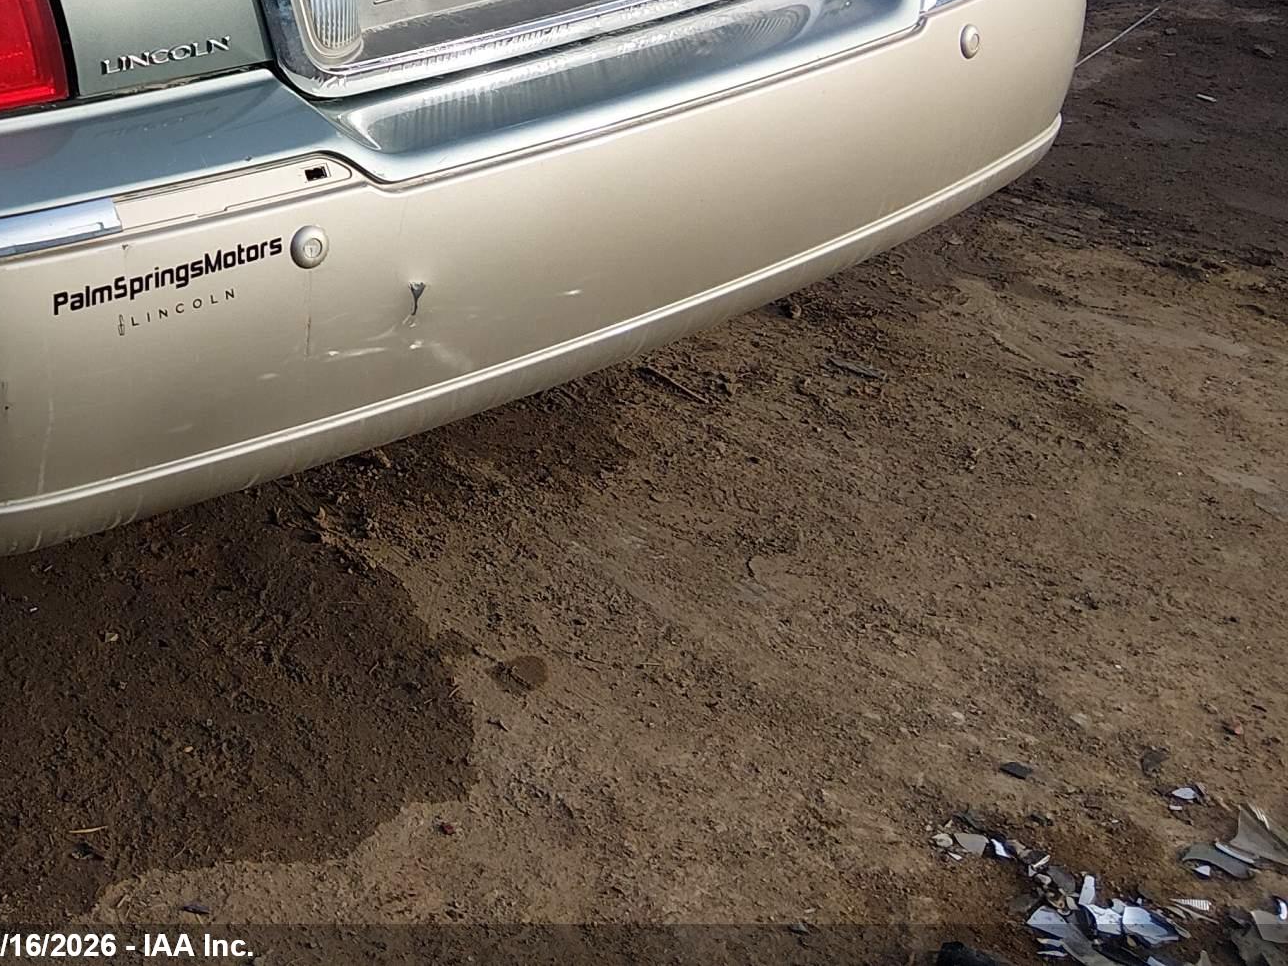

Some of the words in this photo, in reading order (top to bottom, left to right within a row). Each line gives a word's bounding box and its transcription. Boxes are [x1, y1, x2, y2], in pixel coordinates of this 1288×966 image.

[101, 35, 230, 75] LINCOLN
[53, 237, 283, 316] PalmSpringsMotors
[131, 288, 235, 327] LINCOLN
